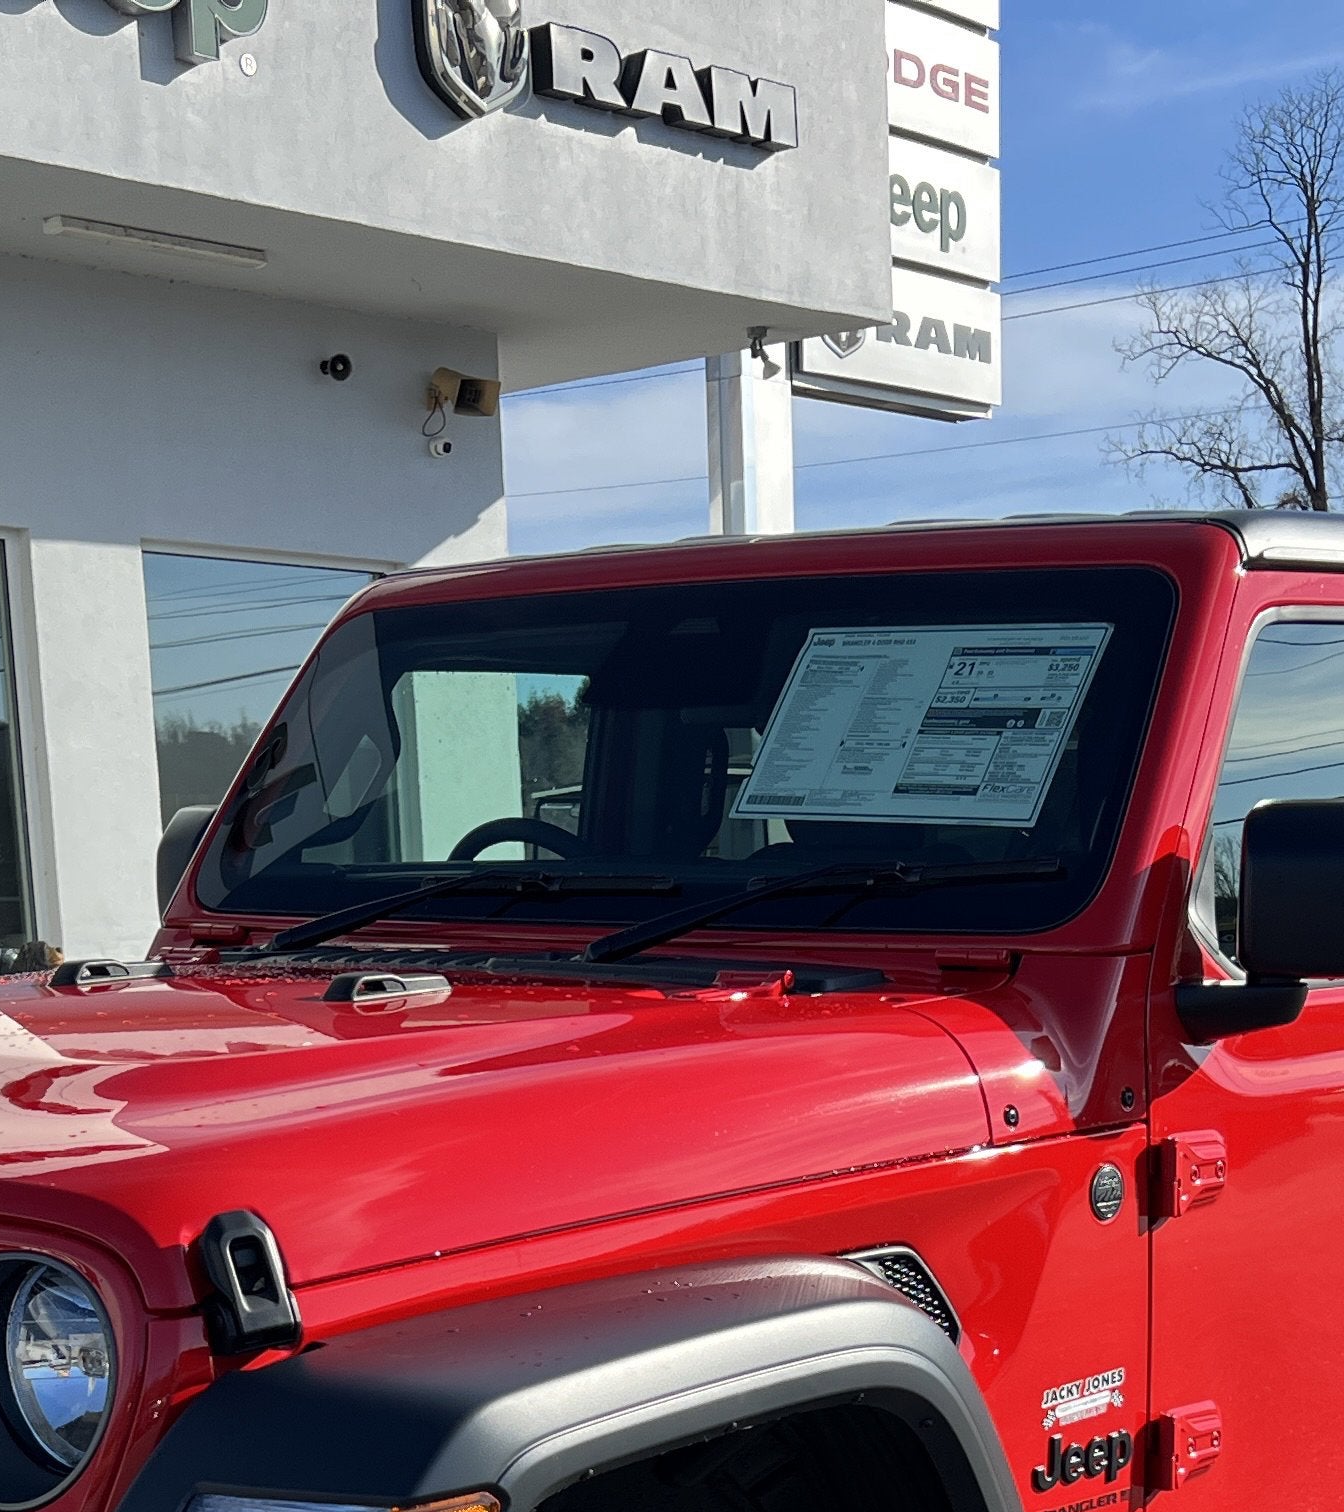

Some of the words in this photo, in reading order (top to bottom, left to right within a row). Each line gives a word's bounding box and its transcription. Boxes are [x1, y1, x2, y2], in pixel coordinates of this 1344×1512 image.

[536, 22, 798, 150] RAM
[885, 48, 990, 114] DGE
[876, 309, 992, 364] RAM
[813, 636, 836, 648] Jeep
[953, 661, 976, 676] 21
[982, 783, 1036, 794] FlexCare
[1043, 1382, 1082, 1406] JACKY
[1085, 1368, 1124, 1393] JONES
[1031, 1429, 1134, 1493] Jeep
